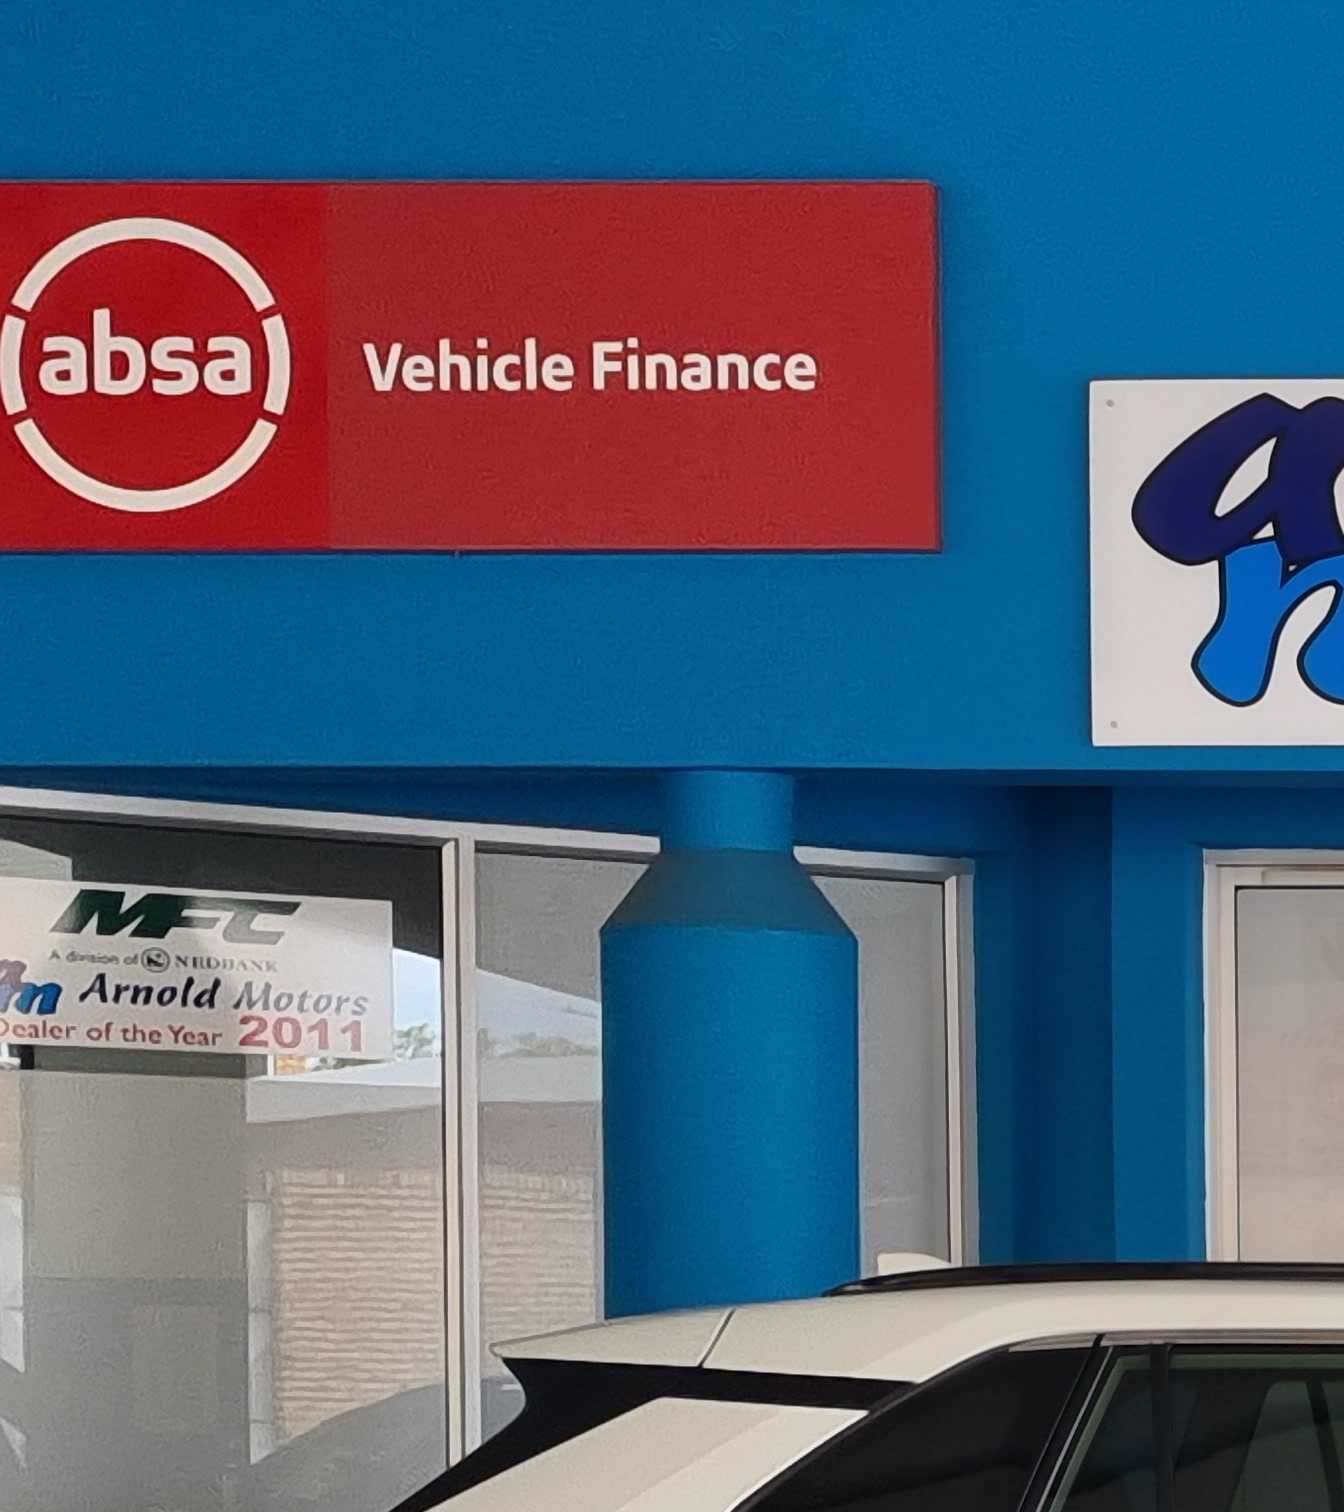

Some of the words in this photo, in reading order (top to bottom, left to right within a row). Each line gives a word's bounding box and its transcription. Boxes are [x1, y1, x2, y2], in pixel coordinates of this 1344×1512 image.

[38, 308, 252, 396] absa
[362, 338, 575, 392] Vehicle
[592, 338, 818, 392] Finance
[50, 889, 301, 946] MFC
[79, 973, 221, 1010] Arnold
[232, 980, 370, 1017] Motors
[86, 1021, 114, 1042] of
[121, 1023, 162, 1045] the
[168, 1024, 223, 1048] Year
[239, 1015, 363, 1053] 2011
